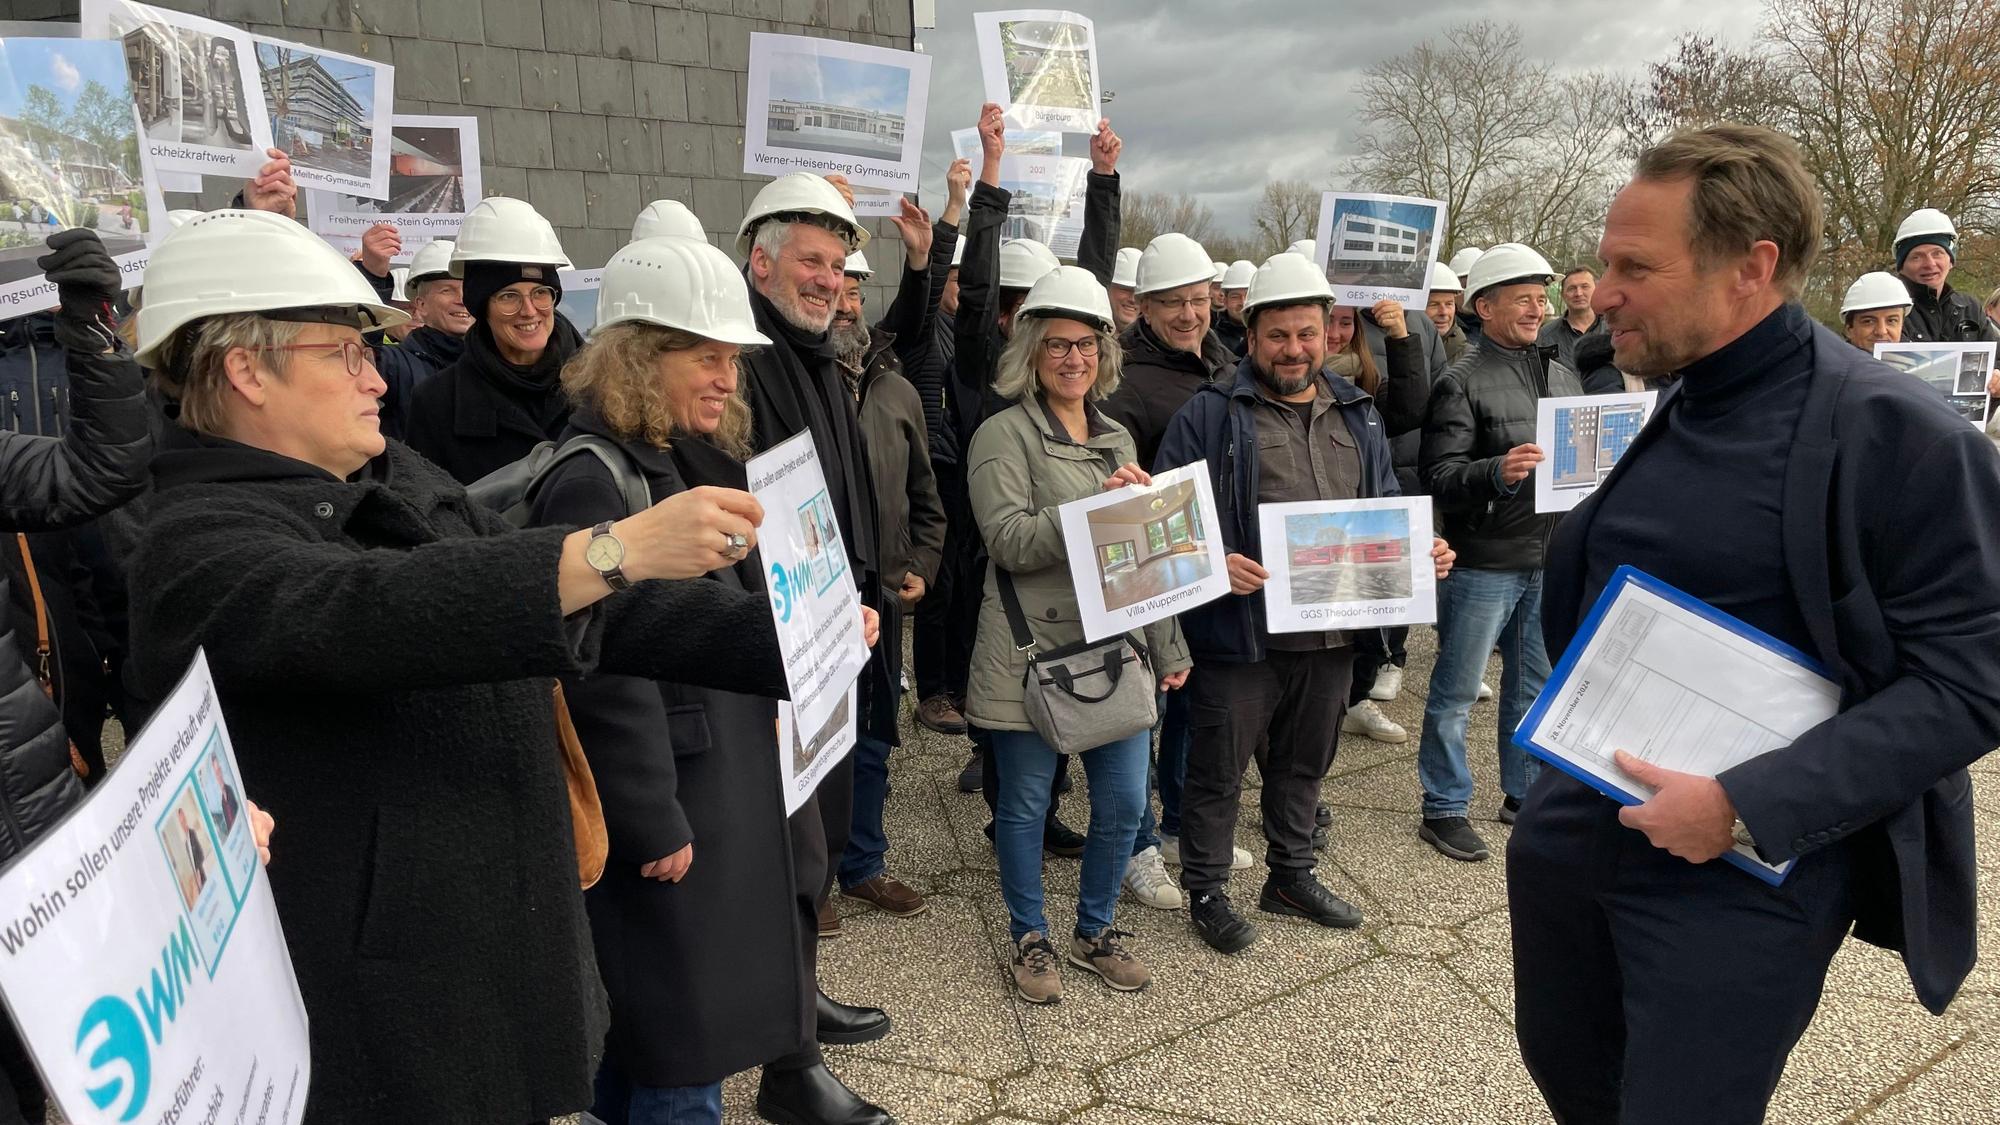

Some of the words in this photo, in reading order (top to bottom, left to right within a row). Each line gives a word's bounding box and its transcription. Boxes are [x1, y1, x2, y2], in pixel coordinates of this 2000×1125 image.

[754, 153, 852, 175] Werner-Heisenberg
[854, 163, 910, 180] Gymnasium
[1030, 166, 1046, 174] 2021
[1126, 605, 1145, 618] Villa
[1145, 584, 1202, 611] Wuppermann
[1300, 609, 1323, 620] GGS
[1324, 605, 1406, 618] Theodor-Fontane
[1550, 726, 1562, 741] 28.
[1557, 697, 1580, 730] November
[1577, 680, 1591, 698] 2024
[0, 890, 67, 956] Wohin
[66, 841, 113, 900] sollen
[109, 800, 143, 852] unsere
[138, 757, 172, 810] Projekte
[169, 714, 199, 765] verkauft
